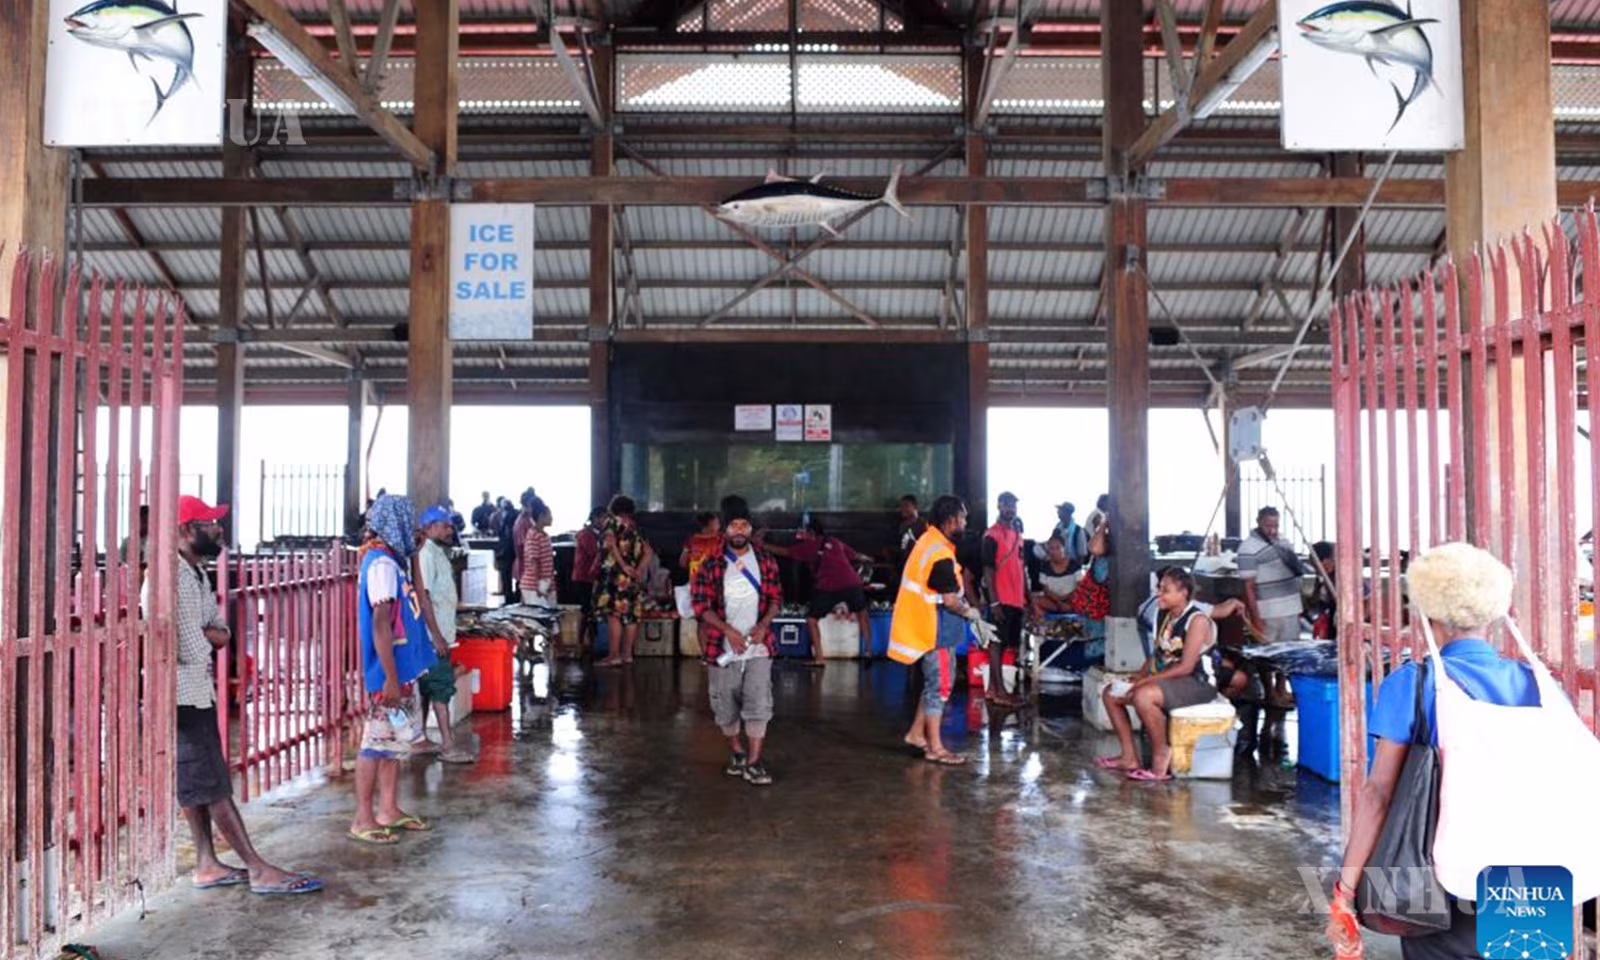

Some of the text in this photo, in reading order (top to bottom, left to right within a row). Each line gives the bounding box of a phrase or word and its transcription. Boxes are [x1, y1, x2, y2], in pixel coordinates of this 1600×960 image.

[469, 224, 514, 242] ICE
[464, 252, 518, 271] FOR
[456, 281, 526, 299] SALE
